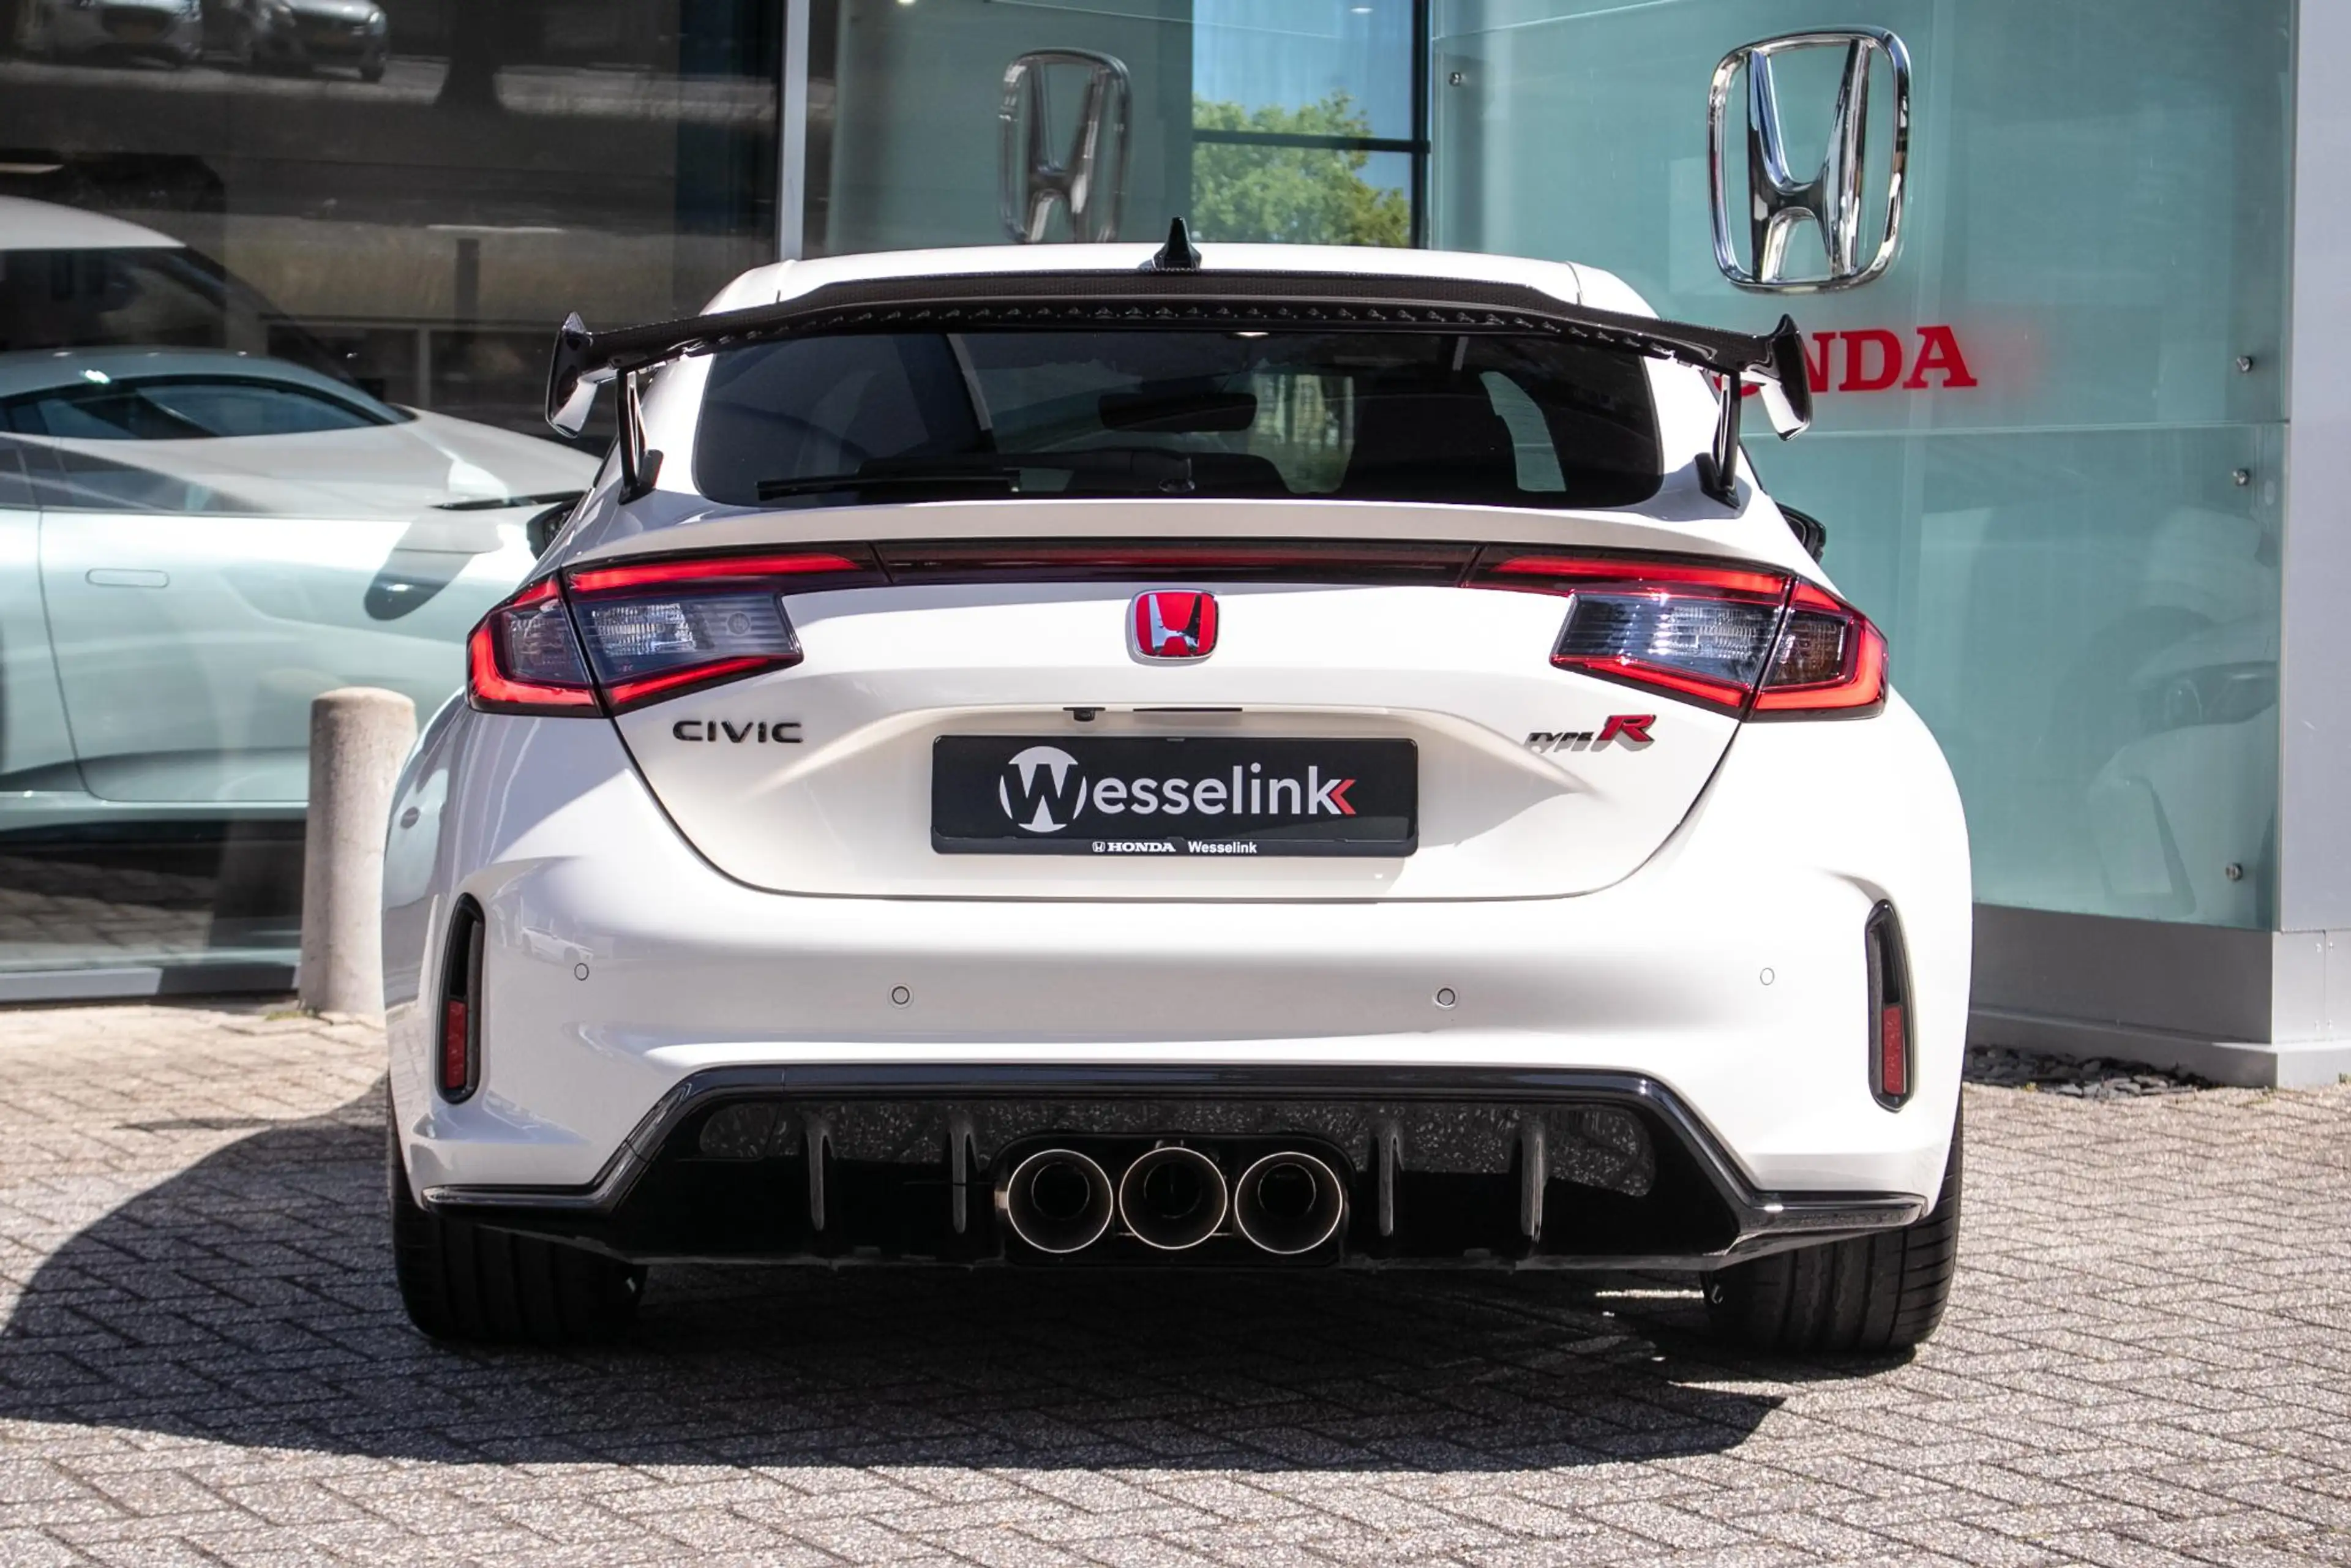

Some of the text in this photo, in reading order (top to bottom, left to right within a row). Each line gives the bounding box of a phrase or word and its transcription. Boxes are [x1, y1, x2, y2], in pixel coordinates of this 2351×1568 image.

[1714, 325, 1978, 397] NDA
[672, 719, 803, 743] CIVIC
[1595, 714, 1657, 742] R
[999, 745, 1356, 833] Wesselink
[1107, 841, 1176, 852] HONDA
[1188, 841, 1258, 853] Wesselink
